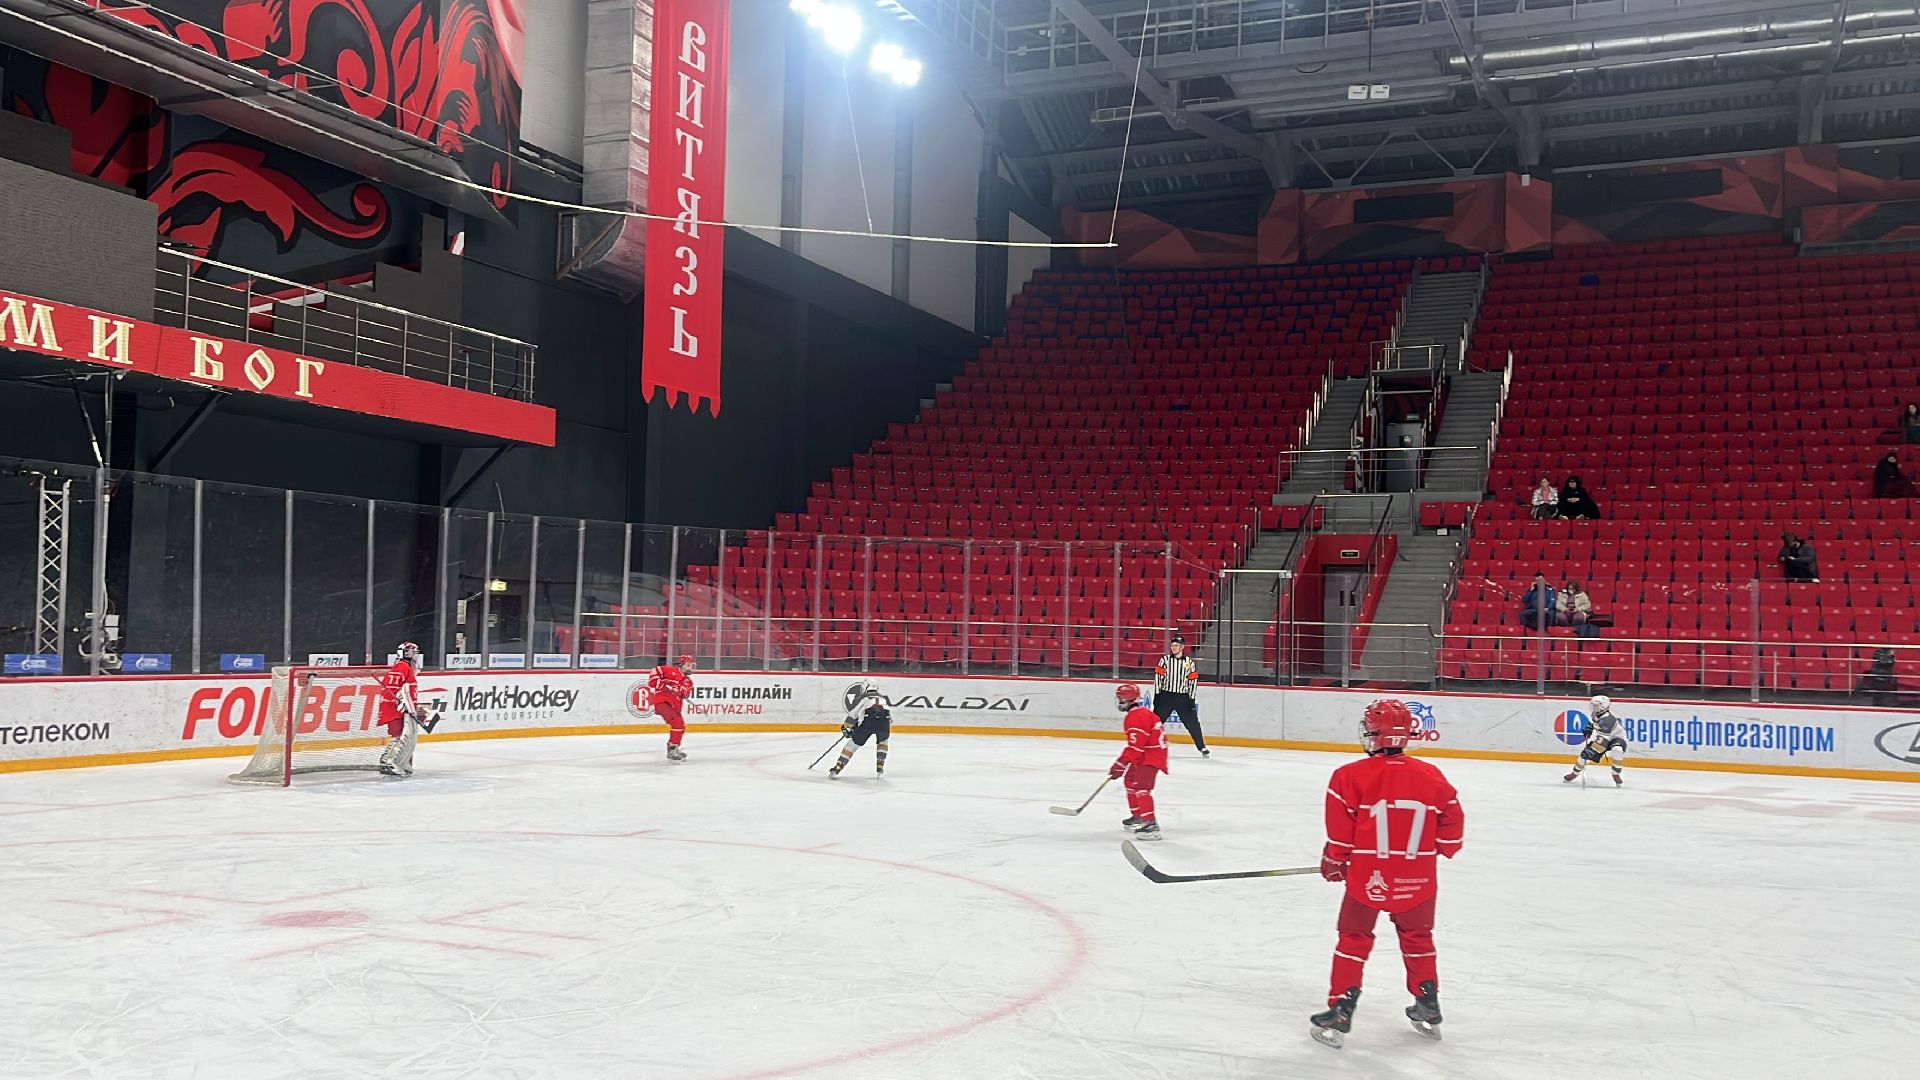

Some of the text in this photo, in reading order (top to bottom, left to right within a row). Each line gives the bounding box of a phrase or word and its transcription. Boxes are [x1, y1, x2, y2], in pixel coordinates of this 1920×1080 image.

[669, 20, 707, 358] ВИТЯЗЬ
[189, 336, 325, 399] БОГ
[453, 684, 580, 713] MarkHockey
[731, 683, 792, 700] ОНЛАЙН
[883, 695, 1030, 711] VALDAI
[461, 710, 555, 722] MAKE YOURSELF
[0, 722, 110, 745] телеком
[1624, 715, 1835, 756] вернефтегазпром
[1369, 799, 1427, 860] 17
